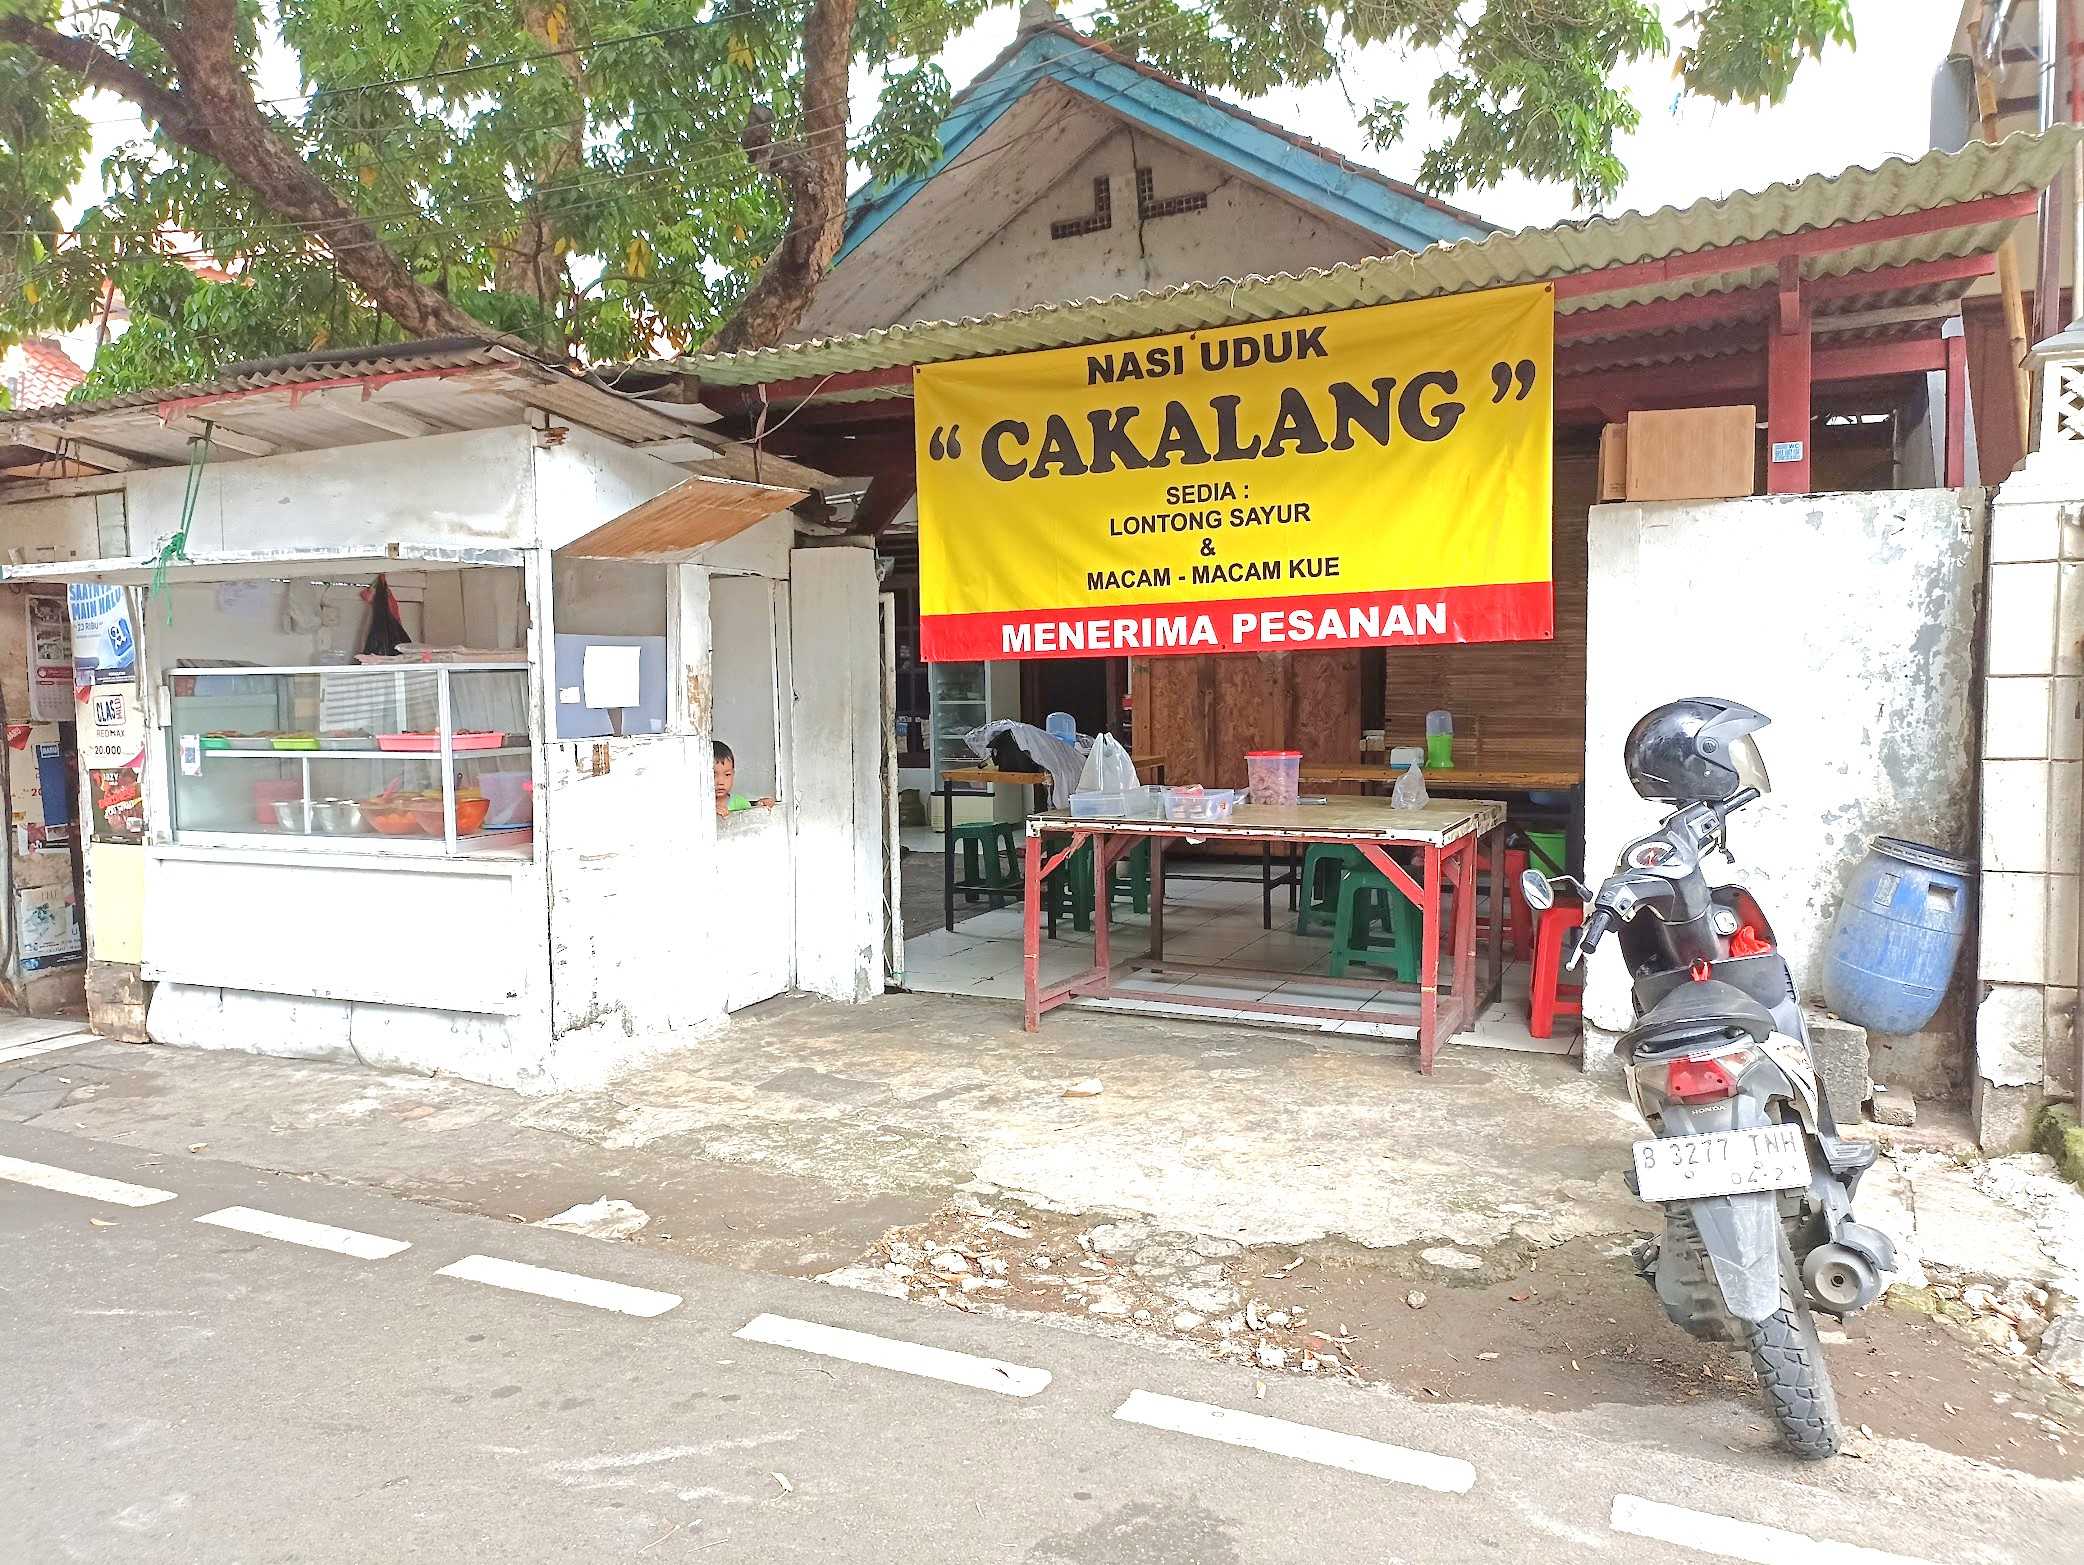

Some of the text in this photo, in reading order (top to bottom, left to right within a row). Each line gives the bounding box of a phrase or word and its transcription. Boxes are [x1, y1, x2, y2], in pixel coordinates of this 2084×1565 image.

[1087, 326, 1329, 386] NASI UDUK
[980, 369, 1466, 482] CAKALANG
[1166, 482, 1236, 505] SEDIA
[1110, 503, 1311, 536] LONTONG SAYUR
[1200, 537, 1216, 557] &
[1087, 567, 1171, 590] MACAM
[1192, 560, 1281, 585] MACAM
[1289, 557, 1340, 579] KUE
[71, 587, 121, 620] MAIN HALU
[1001, 602, 1448, 654] MENERIMA PESANAN
[96, 699, 116, 722] CLAS
[94, 745, 122, 755] 20.000
[1691, 1104, 1728, 1115] HONDA
[1642, 1131, 1797, 1169] B 3277 TNH
